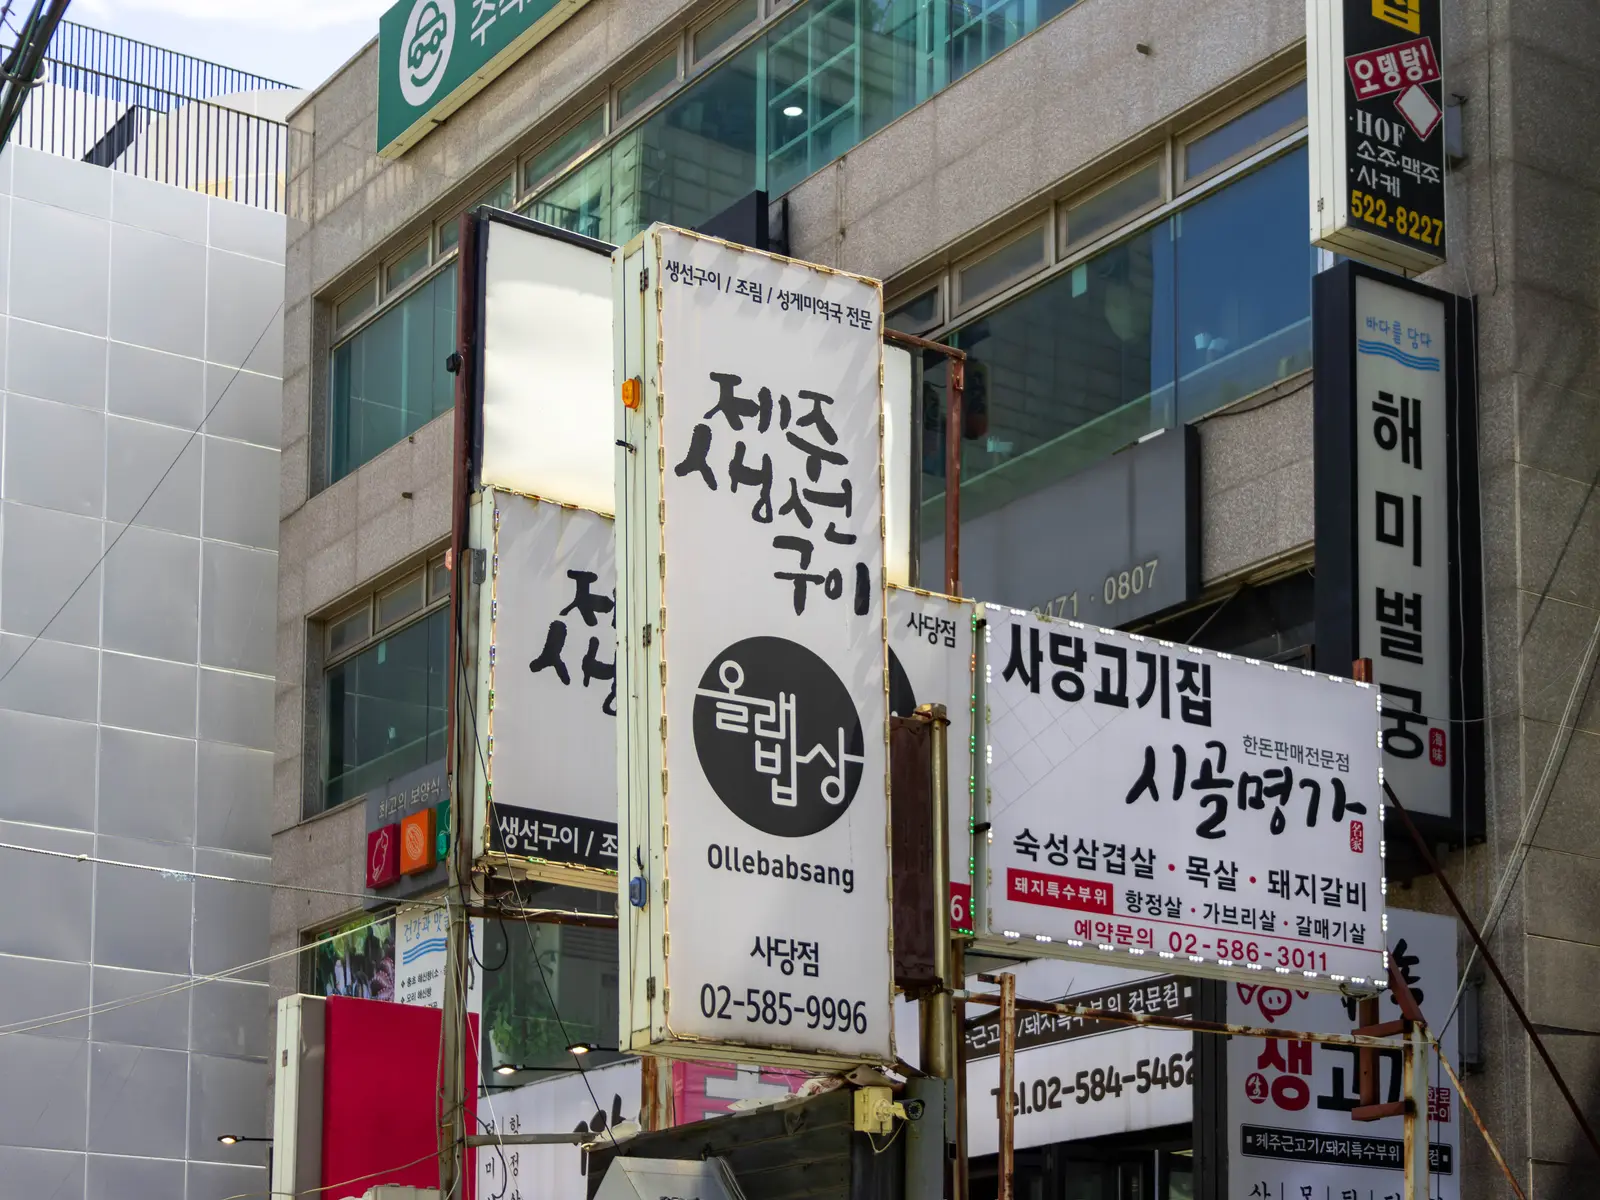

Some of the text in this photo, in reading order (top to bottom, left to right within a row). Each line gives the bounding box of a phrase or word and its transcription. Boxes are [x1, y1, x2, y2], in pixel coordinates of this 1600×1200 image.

[1355, 44, 1433, 94] 오뎅탕!
[1356, 109, 1406, 148] HOF
[1357, 165, 1400, 198] 사케
[1351, 189, 1443, 246] 522-8227
[665, 259, 721, 290] 생선구이
[735, 278, 763, 304] 조림
[776, 289, 843, 324] 성게미역국
[846, 306, 873, 331] 전문
[1366, 316, 1402, 345] 바다를
[703, 371, 848, 486] 제주
[674, 423, 857, 545] 생선
[772, 535, 871, 616] 구이
[1104, 560, 1158, 605] 0807
[1371, 390, 1428, 760] 해미별궁
[907, 611, 956, 648] 사당점
[1002, 623, 1212, 727] 사당고기집
[1243, 734, 1350, 773] 한돈판매전문점
[378, 789, 407, 820] 최고의
[1125, 740, 1367, 839] 시골명가
[500, 815, 579, 855] 생선구이
[707, 843, 855, 894] Ollebabsang
[1013, 828, 1367, 912] 숙성삼겹살 목살 돼지갈비
[1014, 876, 1107, 906] 돼지특수부위
[1074, 918, 1153, 949] 예약문의
[1125, 889, 1366, 945] 항정살 가브리살 갈매기살
[750, 935, 819, 978] 사당점
[700, 982, 868, 1035] 02-585-9996
[1128, 981, 1180, 1015] 전문점
[1255, 1133, 1400, 1163] 제주근고기/돼지특수부위
